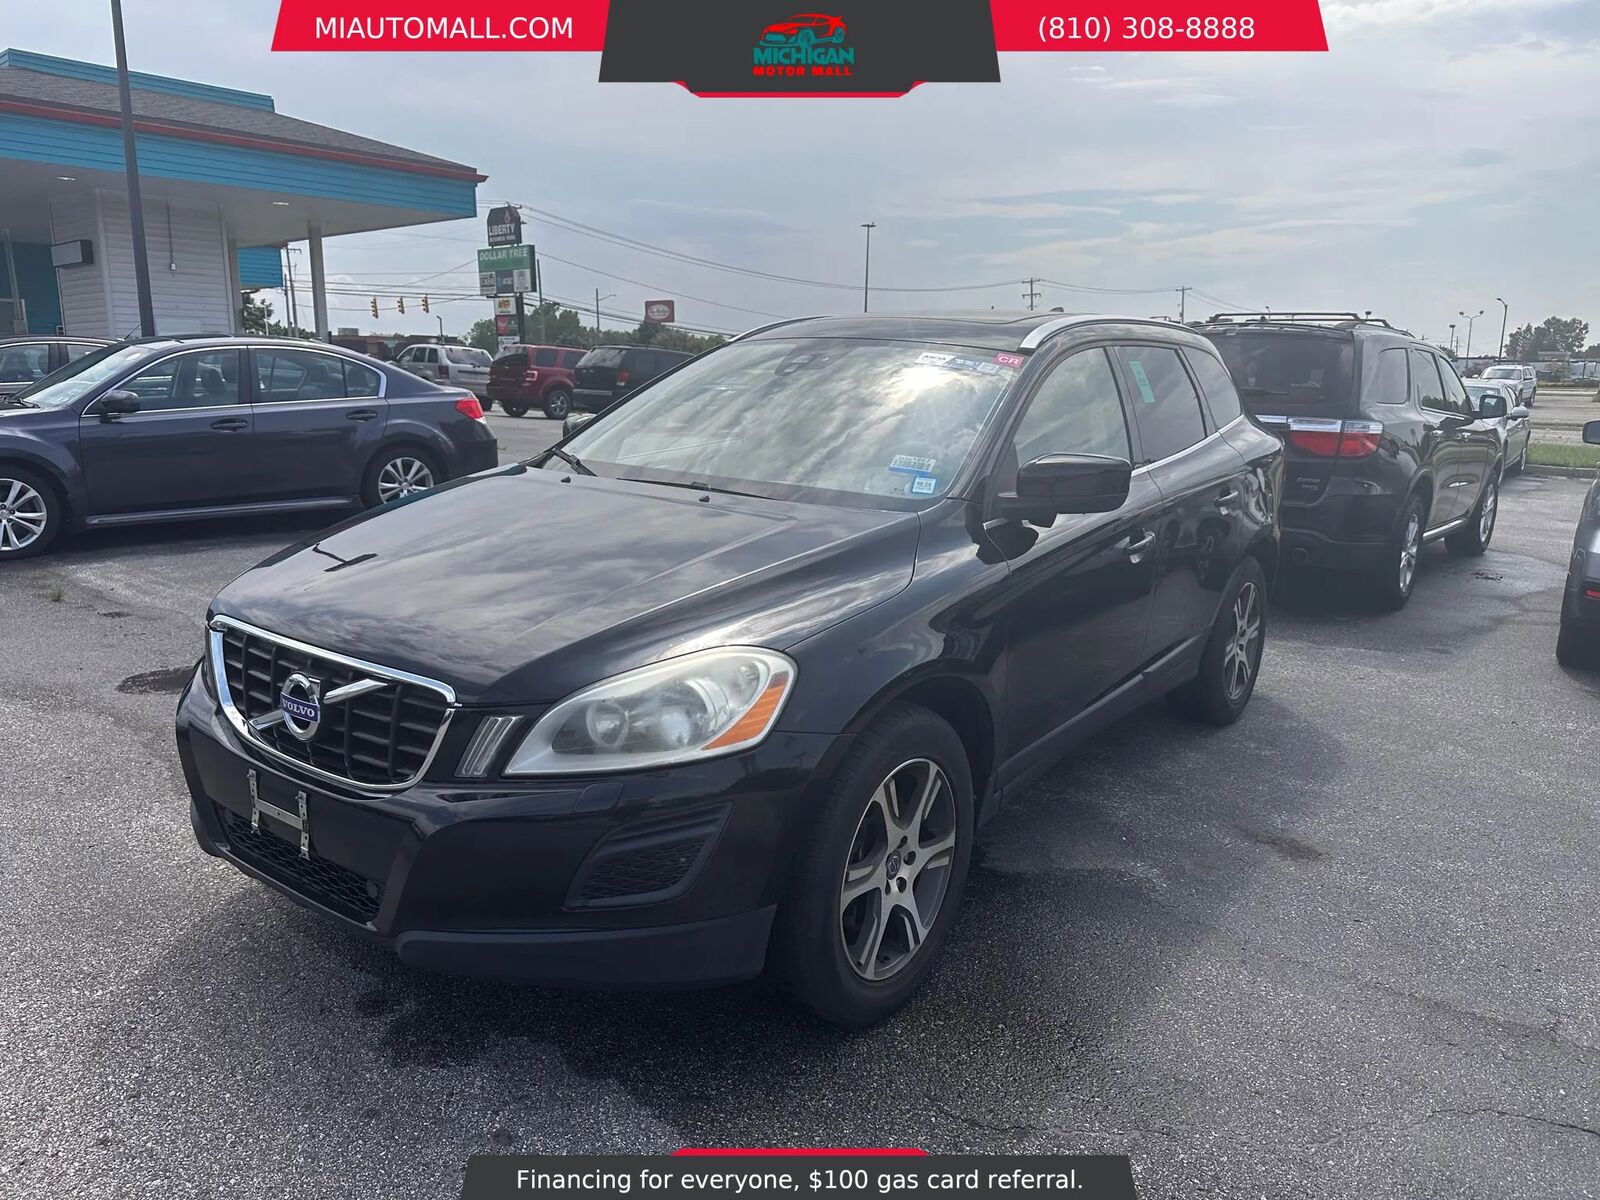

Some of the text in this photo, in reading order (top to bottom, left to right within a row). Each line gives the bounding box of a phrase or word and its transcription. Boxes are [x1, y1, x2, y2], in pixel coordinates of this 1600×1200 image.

[488, 223, 516, 236] LIBERTY
[480, 247, 529, 261] DOLLAR TREE
[998, 356, 1019, 365] CR
[281, 698, 316, 718] VOLVO
